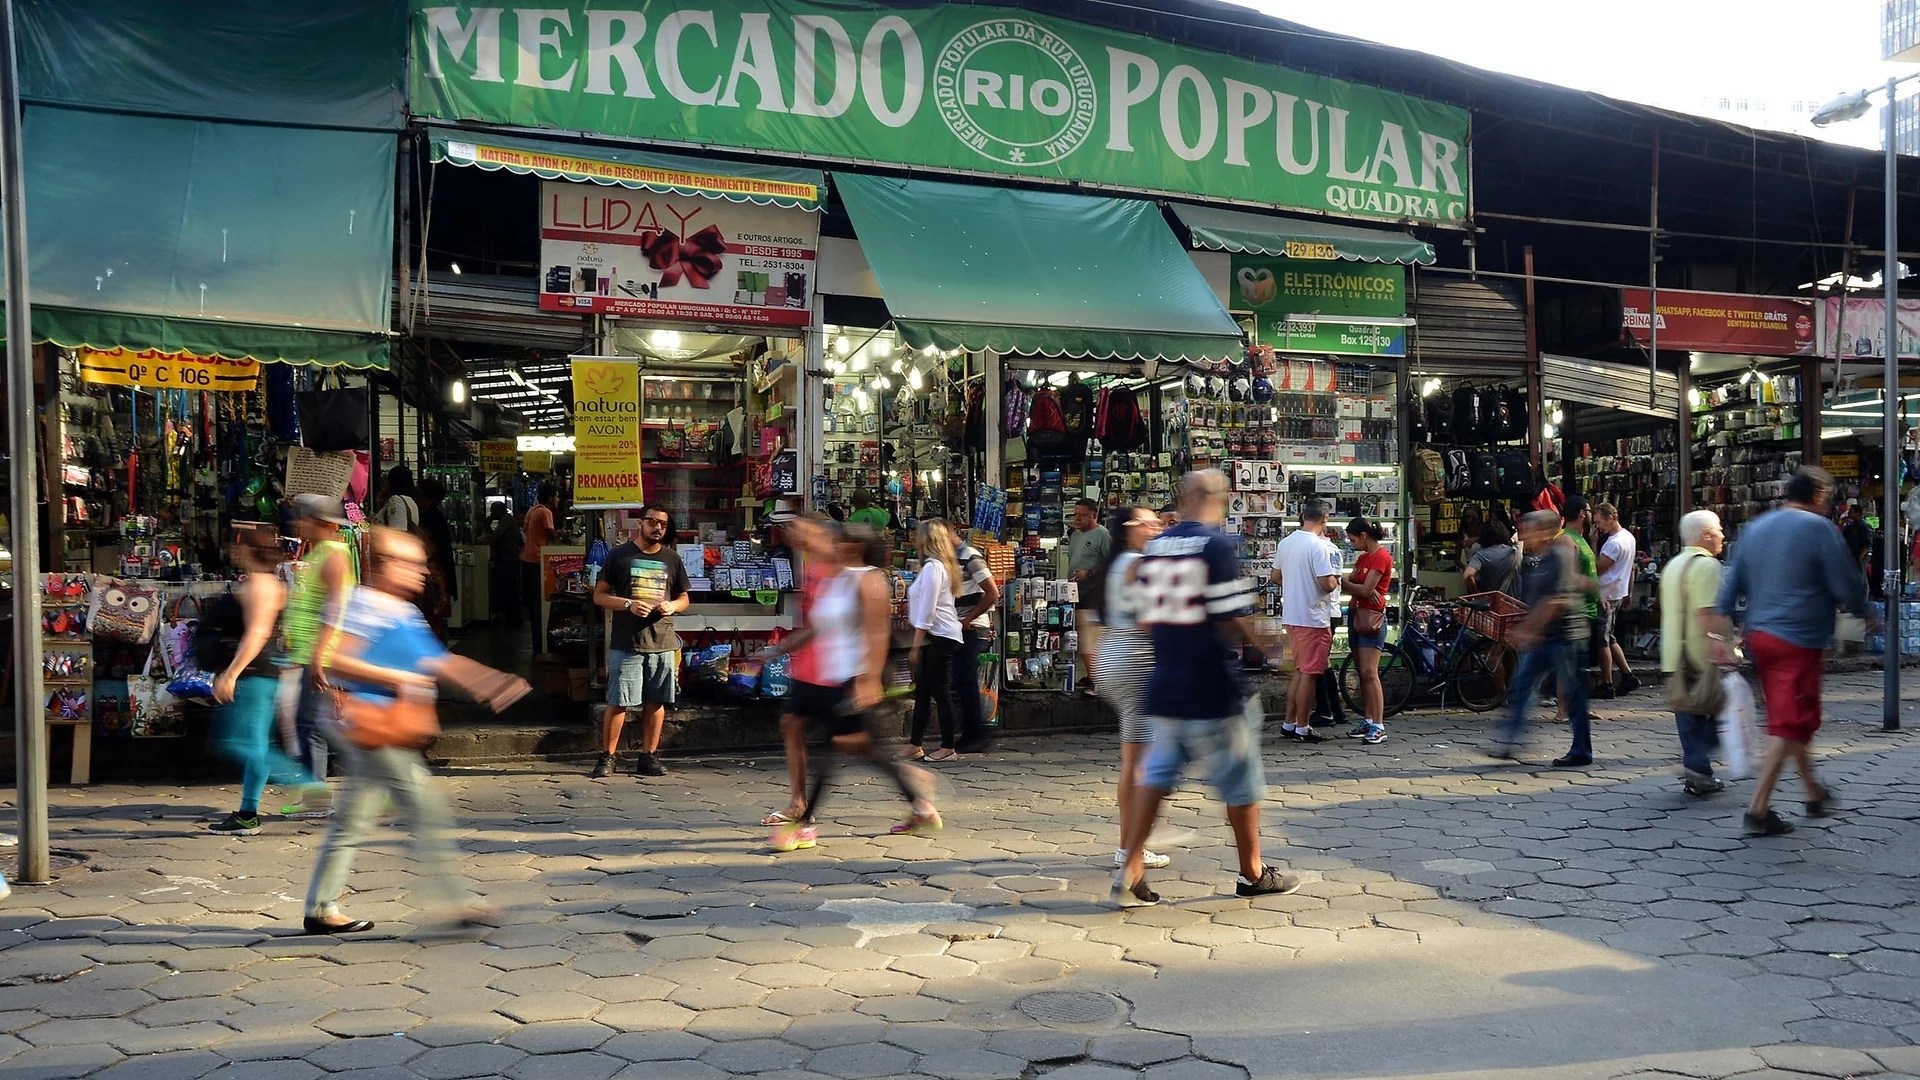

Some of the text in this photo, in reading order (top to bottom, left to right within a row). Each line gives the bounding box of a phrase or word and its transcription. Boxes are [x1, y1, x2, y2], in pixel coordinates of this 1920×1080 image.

[424, 6, 925, 128] MERCADO
[938, 23, 1093, 158] MERCADO POPULAR DA RUA URUGUAIANA
[964, 69, 1071, 116] RIO
[1106, 45, 1464, 196] POPULAR
[480, 148, 521, 165] NATURA
[532, 156, 559, 170] AVON
[561, 159, 573, 172] C/
[575, 161, 597, 174] 20%
[600, 165, 612, 176] de
[614, 166, 665, 182] DESCONTO
[668, 173, 692, 186] PARA
[694, 176, 750, 191] PAGAMENTO
[753, 182, 765, 193] EM
[768, 183, 811, 197] DINHEIRO
[1326, 185, 1464, 220] QUADRA C
[553, 194, 702, 245] LUDAY
[742, 234, 772, 243] OUTROS
[745, 246, 802, 258] DESDE 1995
[1288, 243, 1334, 257] 129 130
[739, 258, 805, 270] TEL.: 2531-8304
[1284, 272, 1395, 293] ELETRÔNICOS
[1284, 289, 1344, 299] ACESSÓRIOS
[678, 305, 719, 313] URUGUAIANA
[1656, 306, 1692, 317] WHATSAPP,
[1693, 308, 1726, 318] FACEBOOK
[1727, 310, 1732, 318] E
[1733, 310, 1762, 320] TWITTER
[1764, 311, 1787, 321] GRÁTIS
[1623, 315, 1663, 326] RBINAA
[1727, 319, 1788, 330] DENTRO DA FRANQUIA
[1349, 325, 1373, 334] Quadra
[1341, 334, 1357, 345] Box
[155, 366, 169, 382] C
[179, 367, 210, 385] 106
[574, 397, 636, 413] natura
[619, 414, 636, 422] bem
[588, 425, 624, 434] AVON
[618, 440, 637, 449] 20%
[577, 470, 639, 491] PROMOÇÕES
